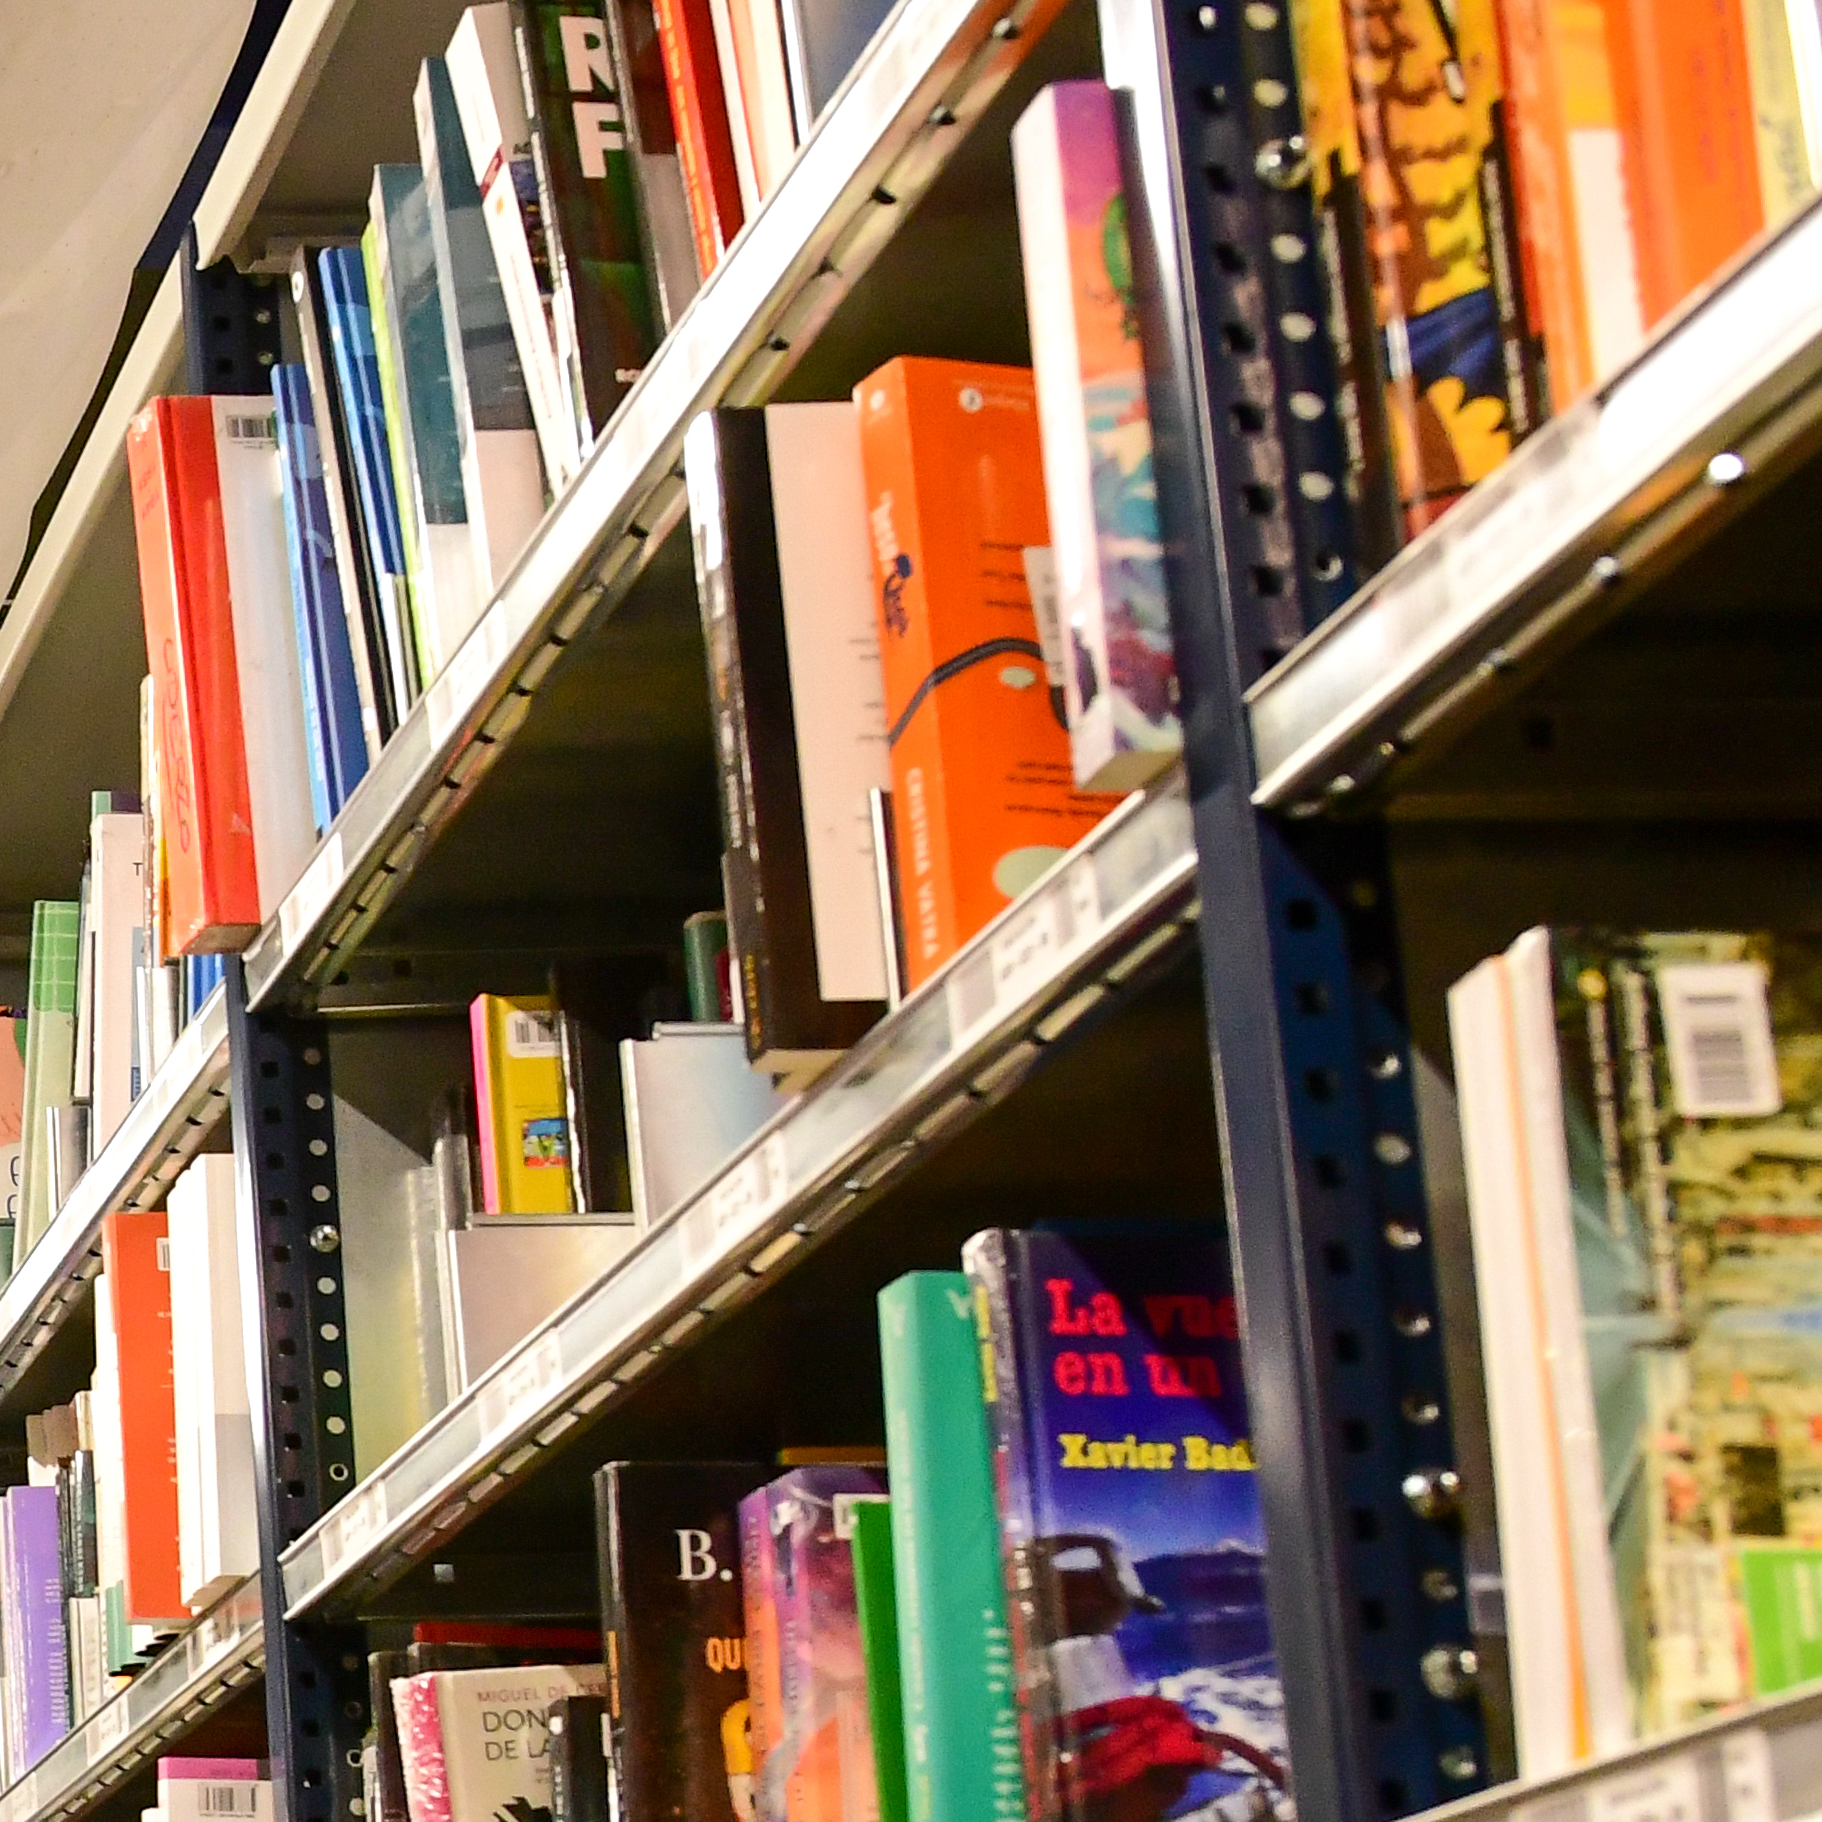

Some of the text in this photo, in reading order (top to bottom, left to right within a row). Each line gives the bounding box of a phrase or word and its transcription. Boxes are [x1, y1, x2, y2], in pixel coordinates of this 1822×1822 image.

[906, 768, 933, 878] CRISTINA
[1045, 1278, 1128, 1337] La
[1055, 1351, 1224, 1398] en un
[1059, 1432, 1177, 1469] Xavier
[675, 1526, 733, 1582] B.
[477, 1689, 539, 1703] MIGUEL
[484, 1740, 519, 1762] DE
